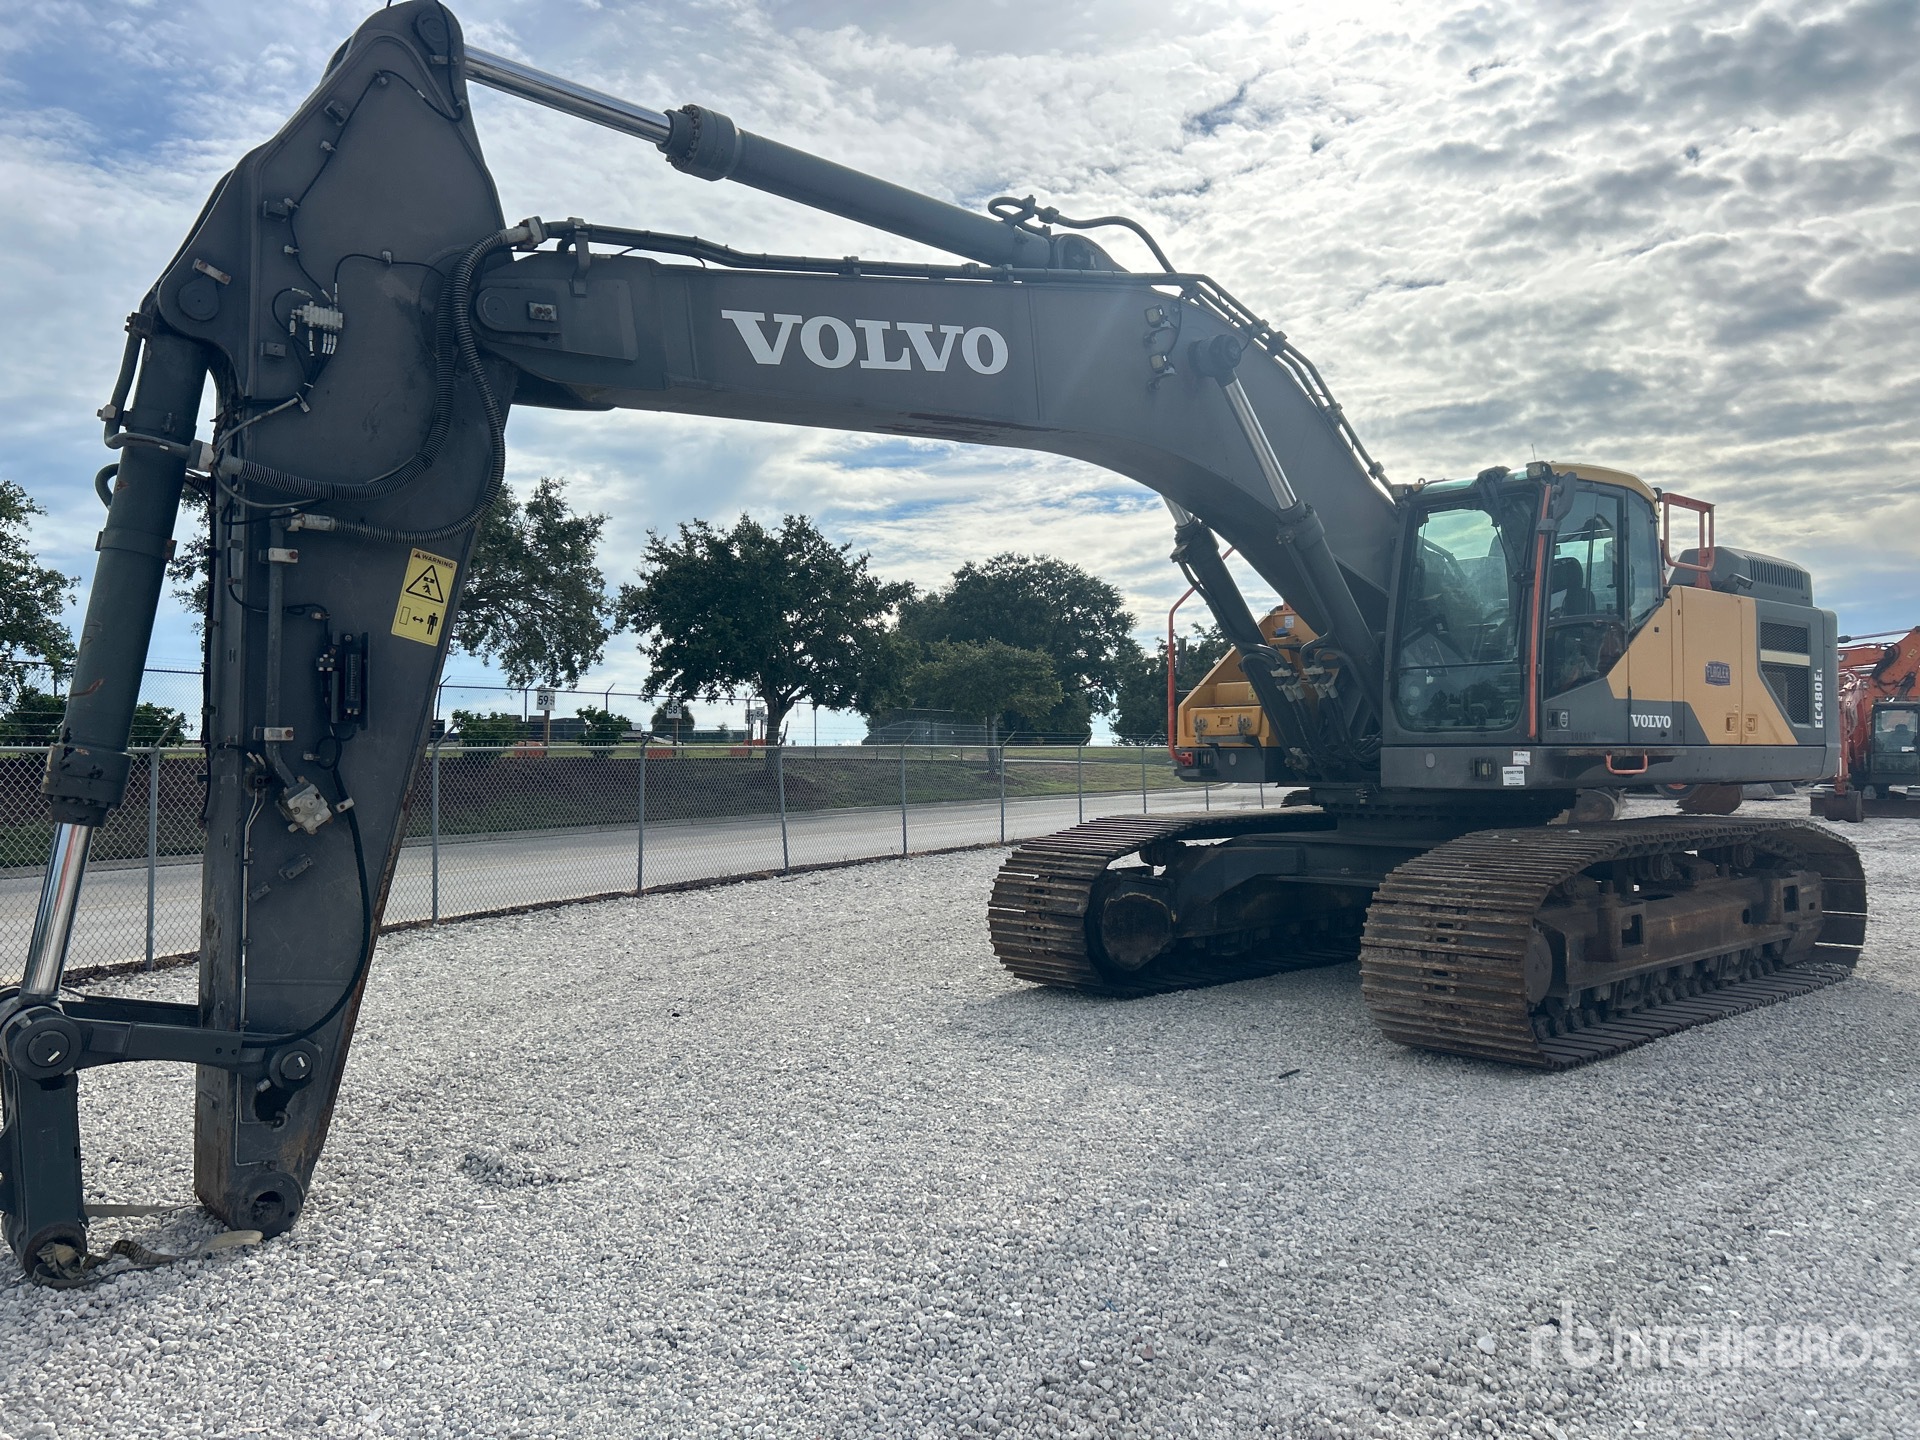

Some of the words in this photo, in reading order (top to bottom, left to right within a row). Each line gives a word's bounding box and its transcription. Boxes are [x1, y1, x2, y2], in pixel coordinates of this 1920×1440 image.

[721, 309, 1009, 375] VOLVO
[422, 554, 454, 569] WARNING
[538, 695, 549, 706] 59
[668, 705, 678, 715] 58
[1630, 714, 1671, 729] VOLVO
